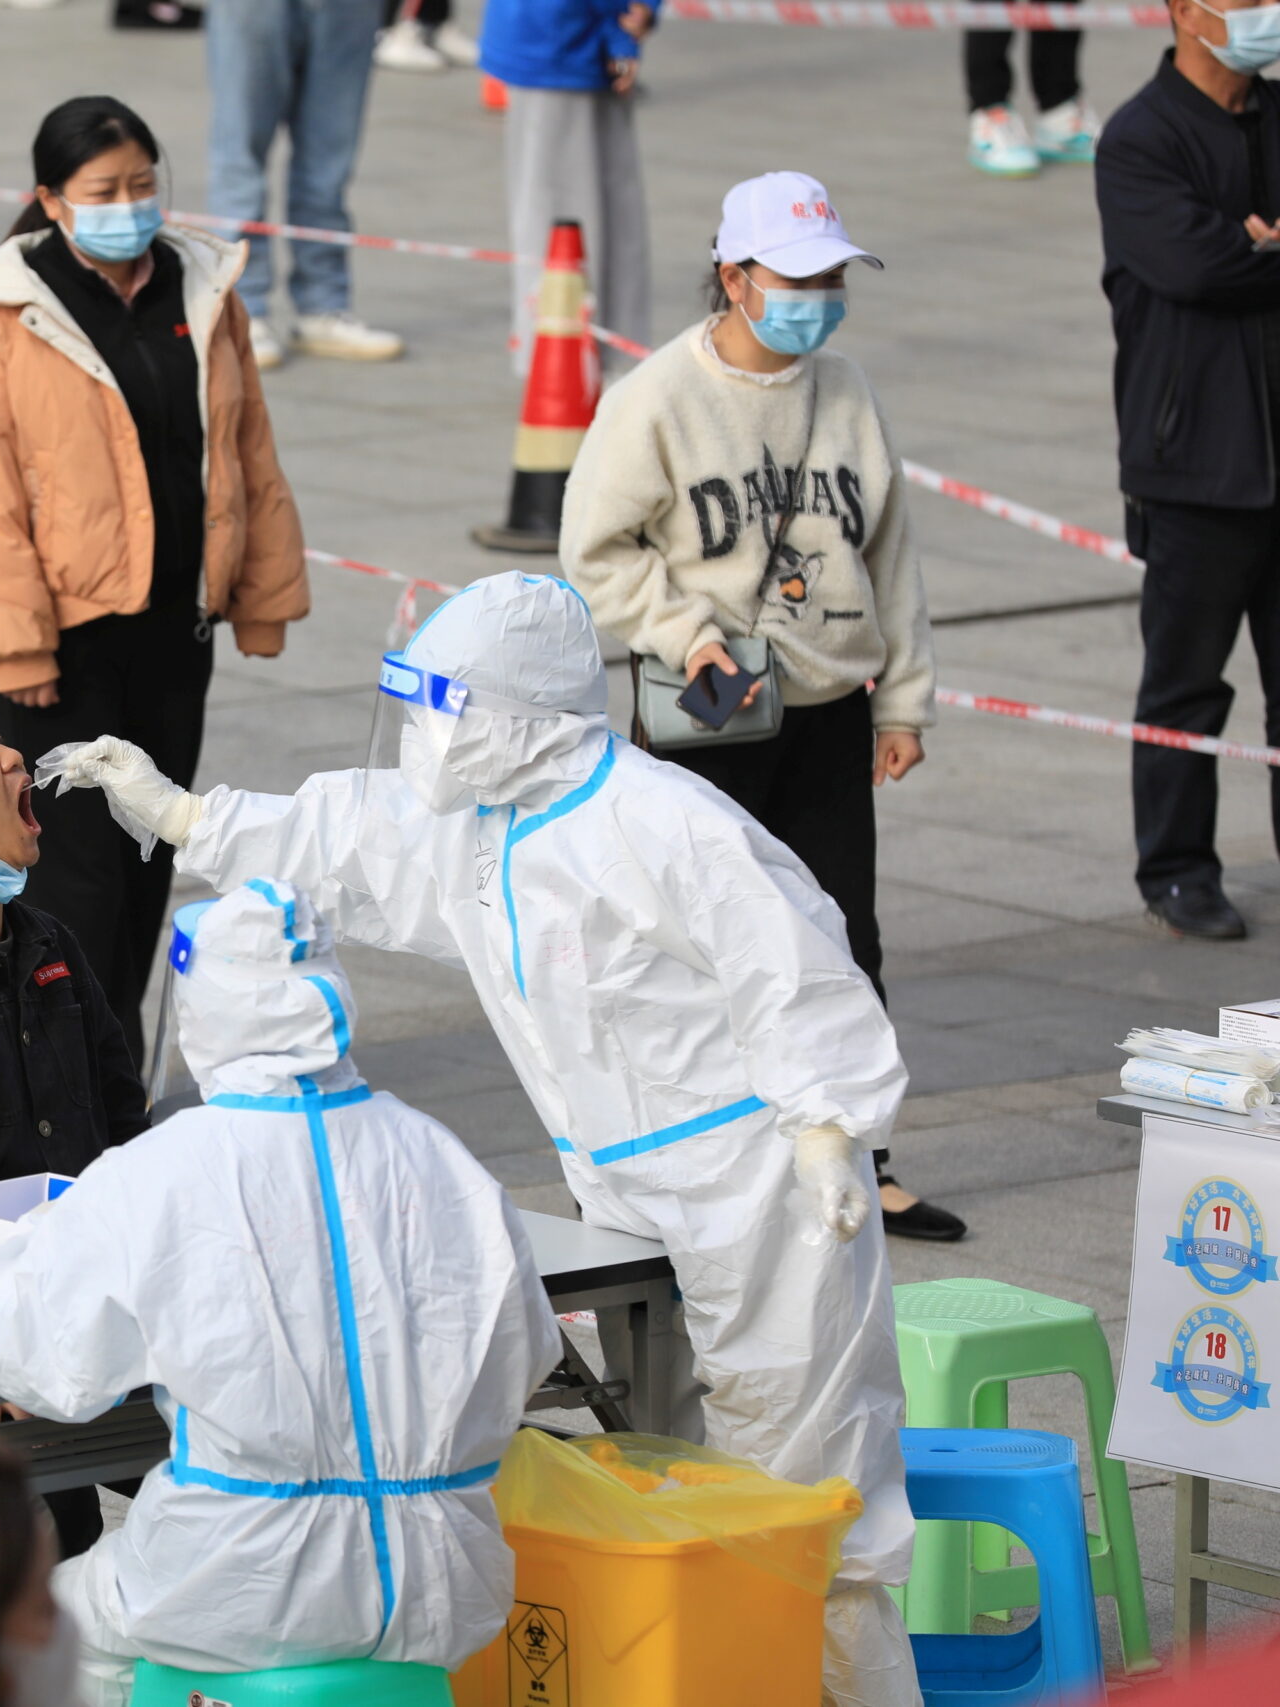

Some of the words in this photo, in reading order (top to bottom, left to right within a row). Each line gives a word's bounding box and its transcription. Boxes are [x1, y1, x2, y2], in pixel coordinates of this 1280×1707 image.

[689, 464, 865, 560] DALLAS
[1213, 1205, 1231, 1232] 17
[1205, 1332, 1227, 1359] 18
